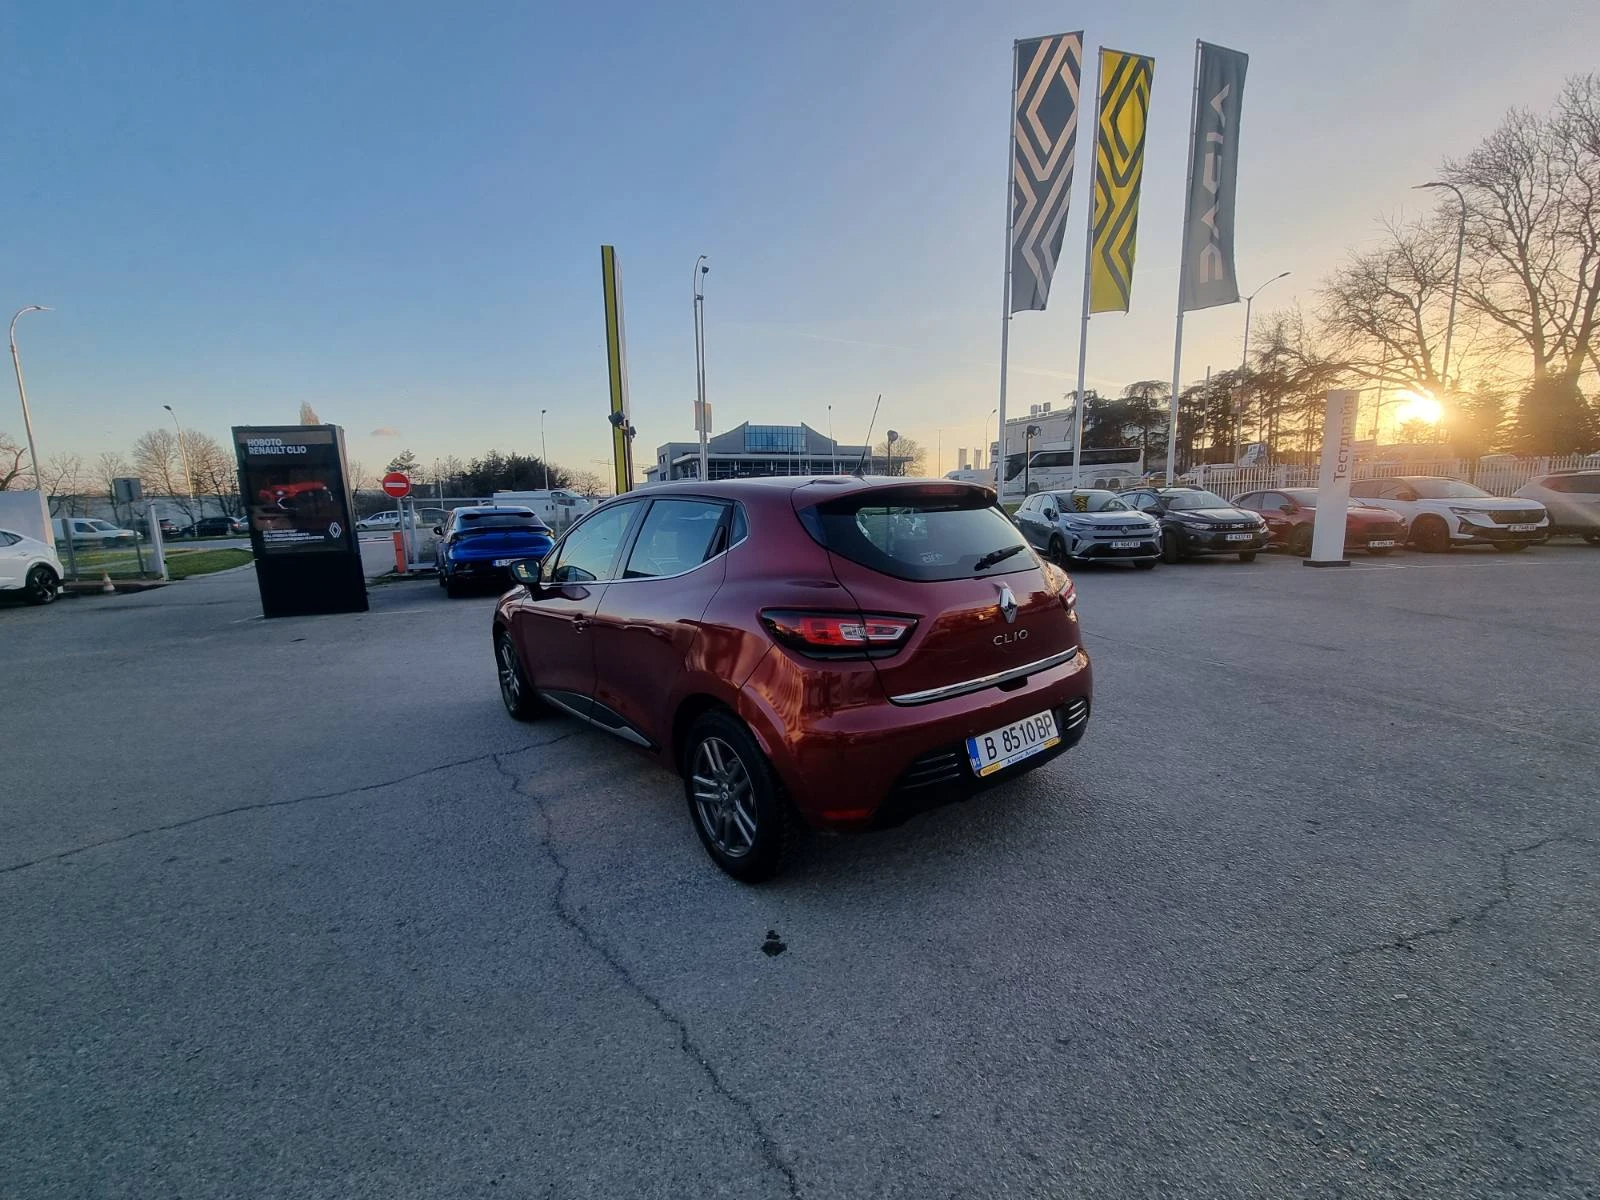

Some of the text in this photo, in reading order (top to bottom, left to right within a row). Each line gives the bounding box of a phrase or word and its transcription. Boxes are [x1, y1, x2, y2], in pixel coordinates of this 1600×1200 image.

[1199, 83, 1230, 284] DACIA
[247, 438, 282, 447] НОВОТО
[248, 445, 307, 455] RENAULT CLIO
[993, 629, 1029, 646] CLIO
[984, 736, 998, 760] B
[1001, 721, 1036, 753] 8510
